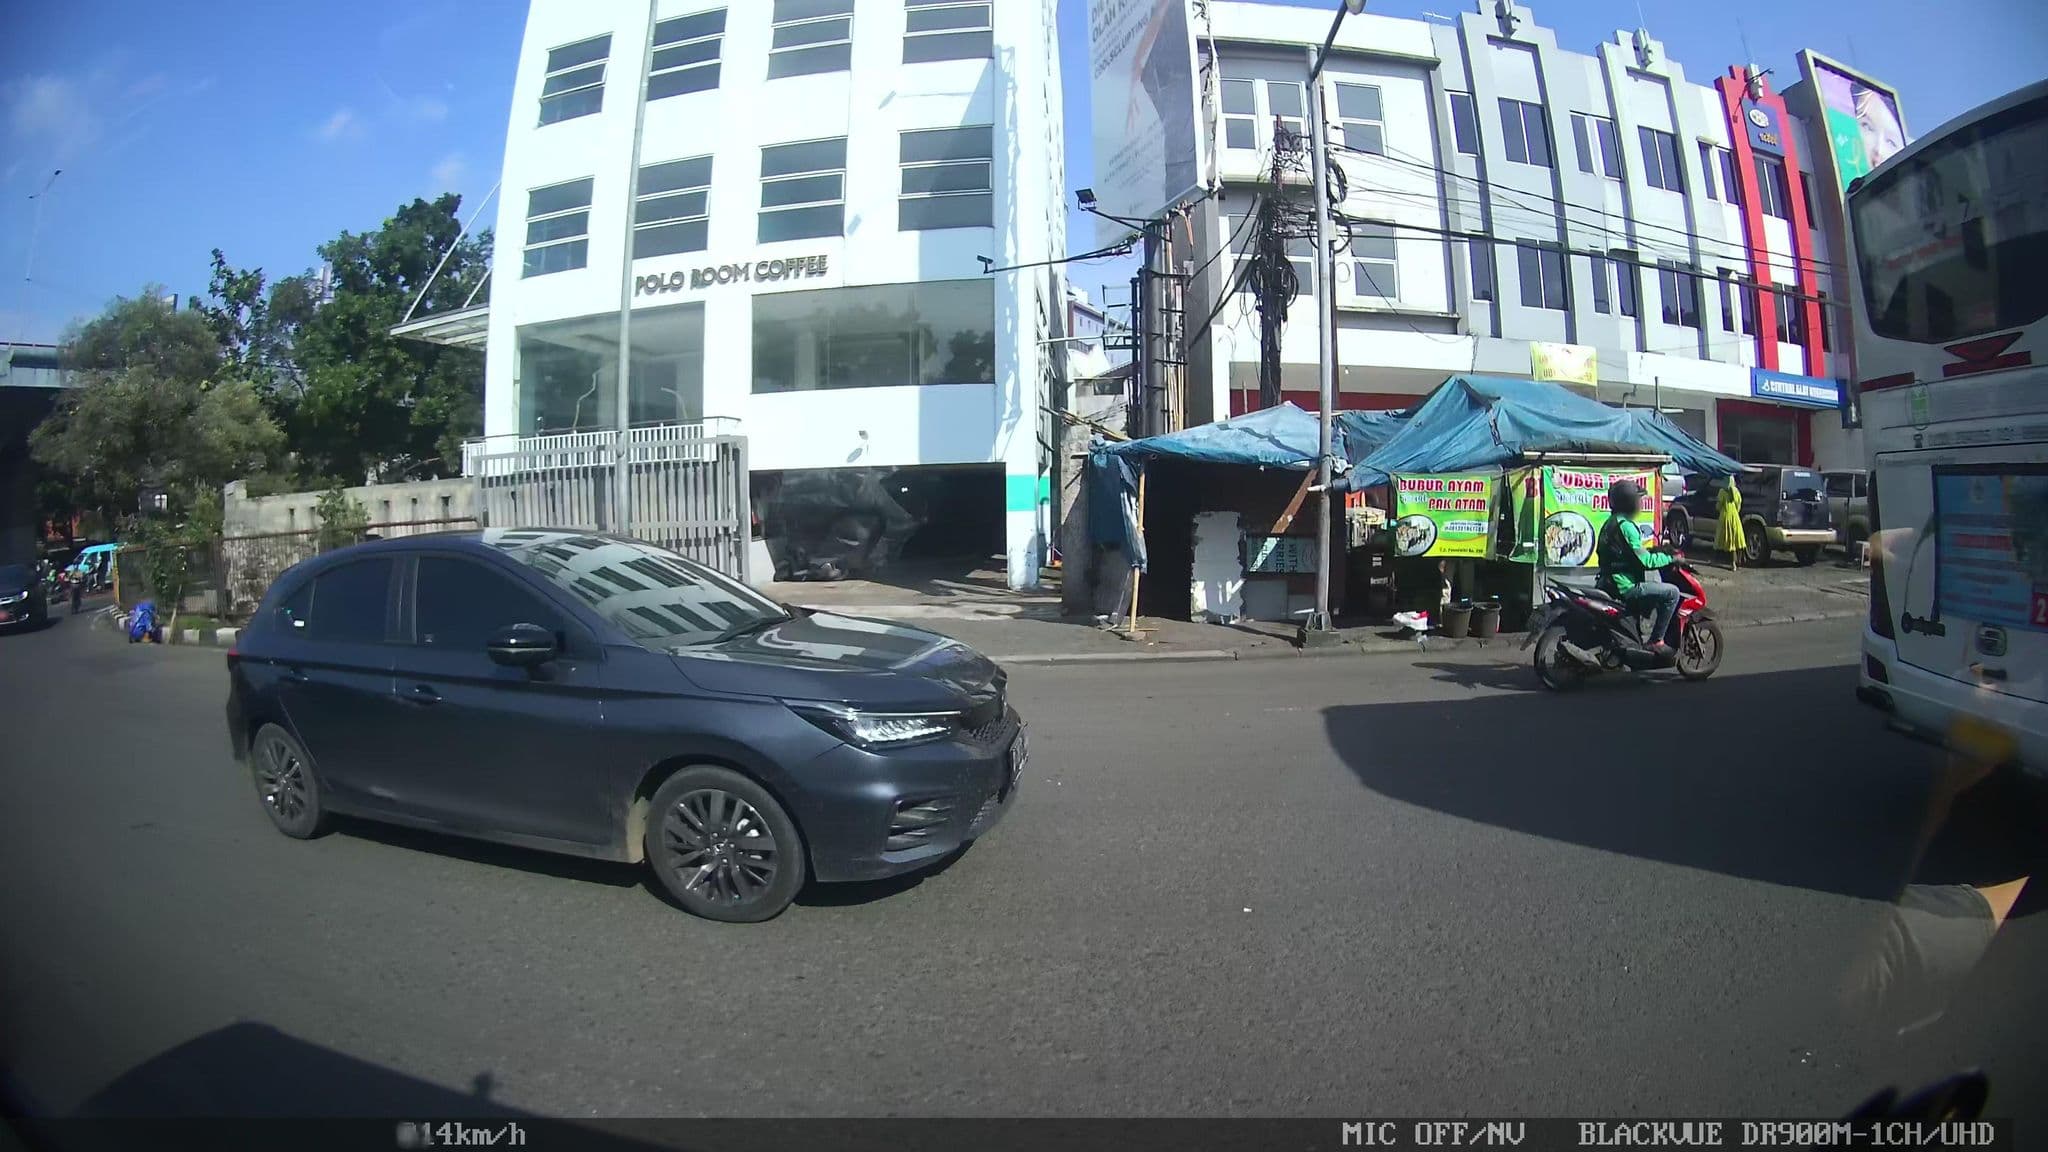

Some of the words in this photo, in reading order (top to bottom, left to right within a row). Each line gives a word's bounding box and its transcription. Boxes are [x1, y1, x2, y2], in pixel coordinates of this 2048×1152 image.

[635, 271, 685, 297] POLO
[690, 262, 752, 291] ROOM
[755, 254, 828, 282] COFFEE
[1399, 479, 1444, 492] BUBUR
[1447, 480, 1485, 493] AYAM
[1558, 472, 1604, 489] UBUR
[1428, 498, 1451, 511] PAK
